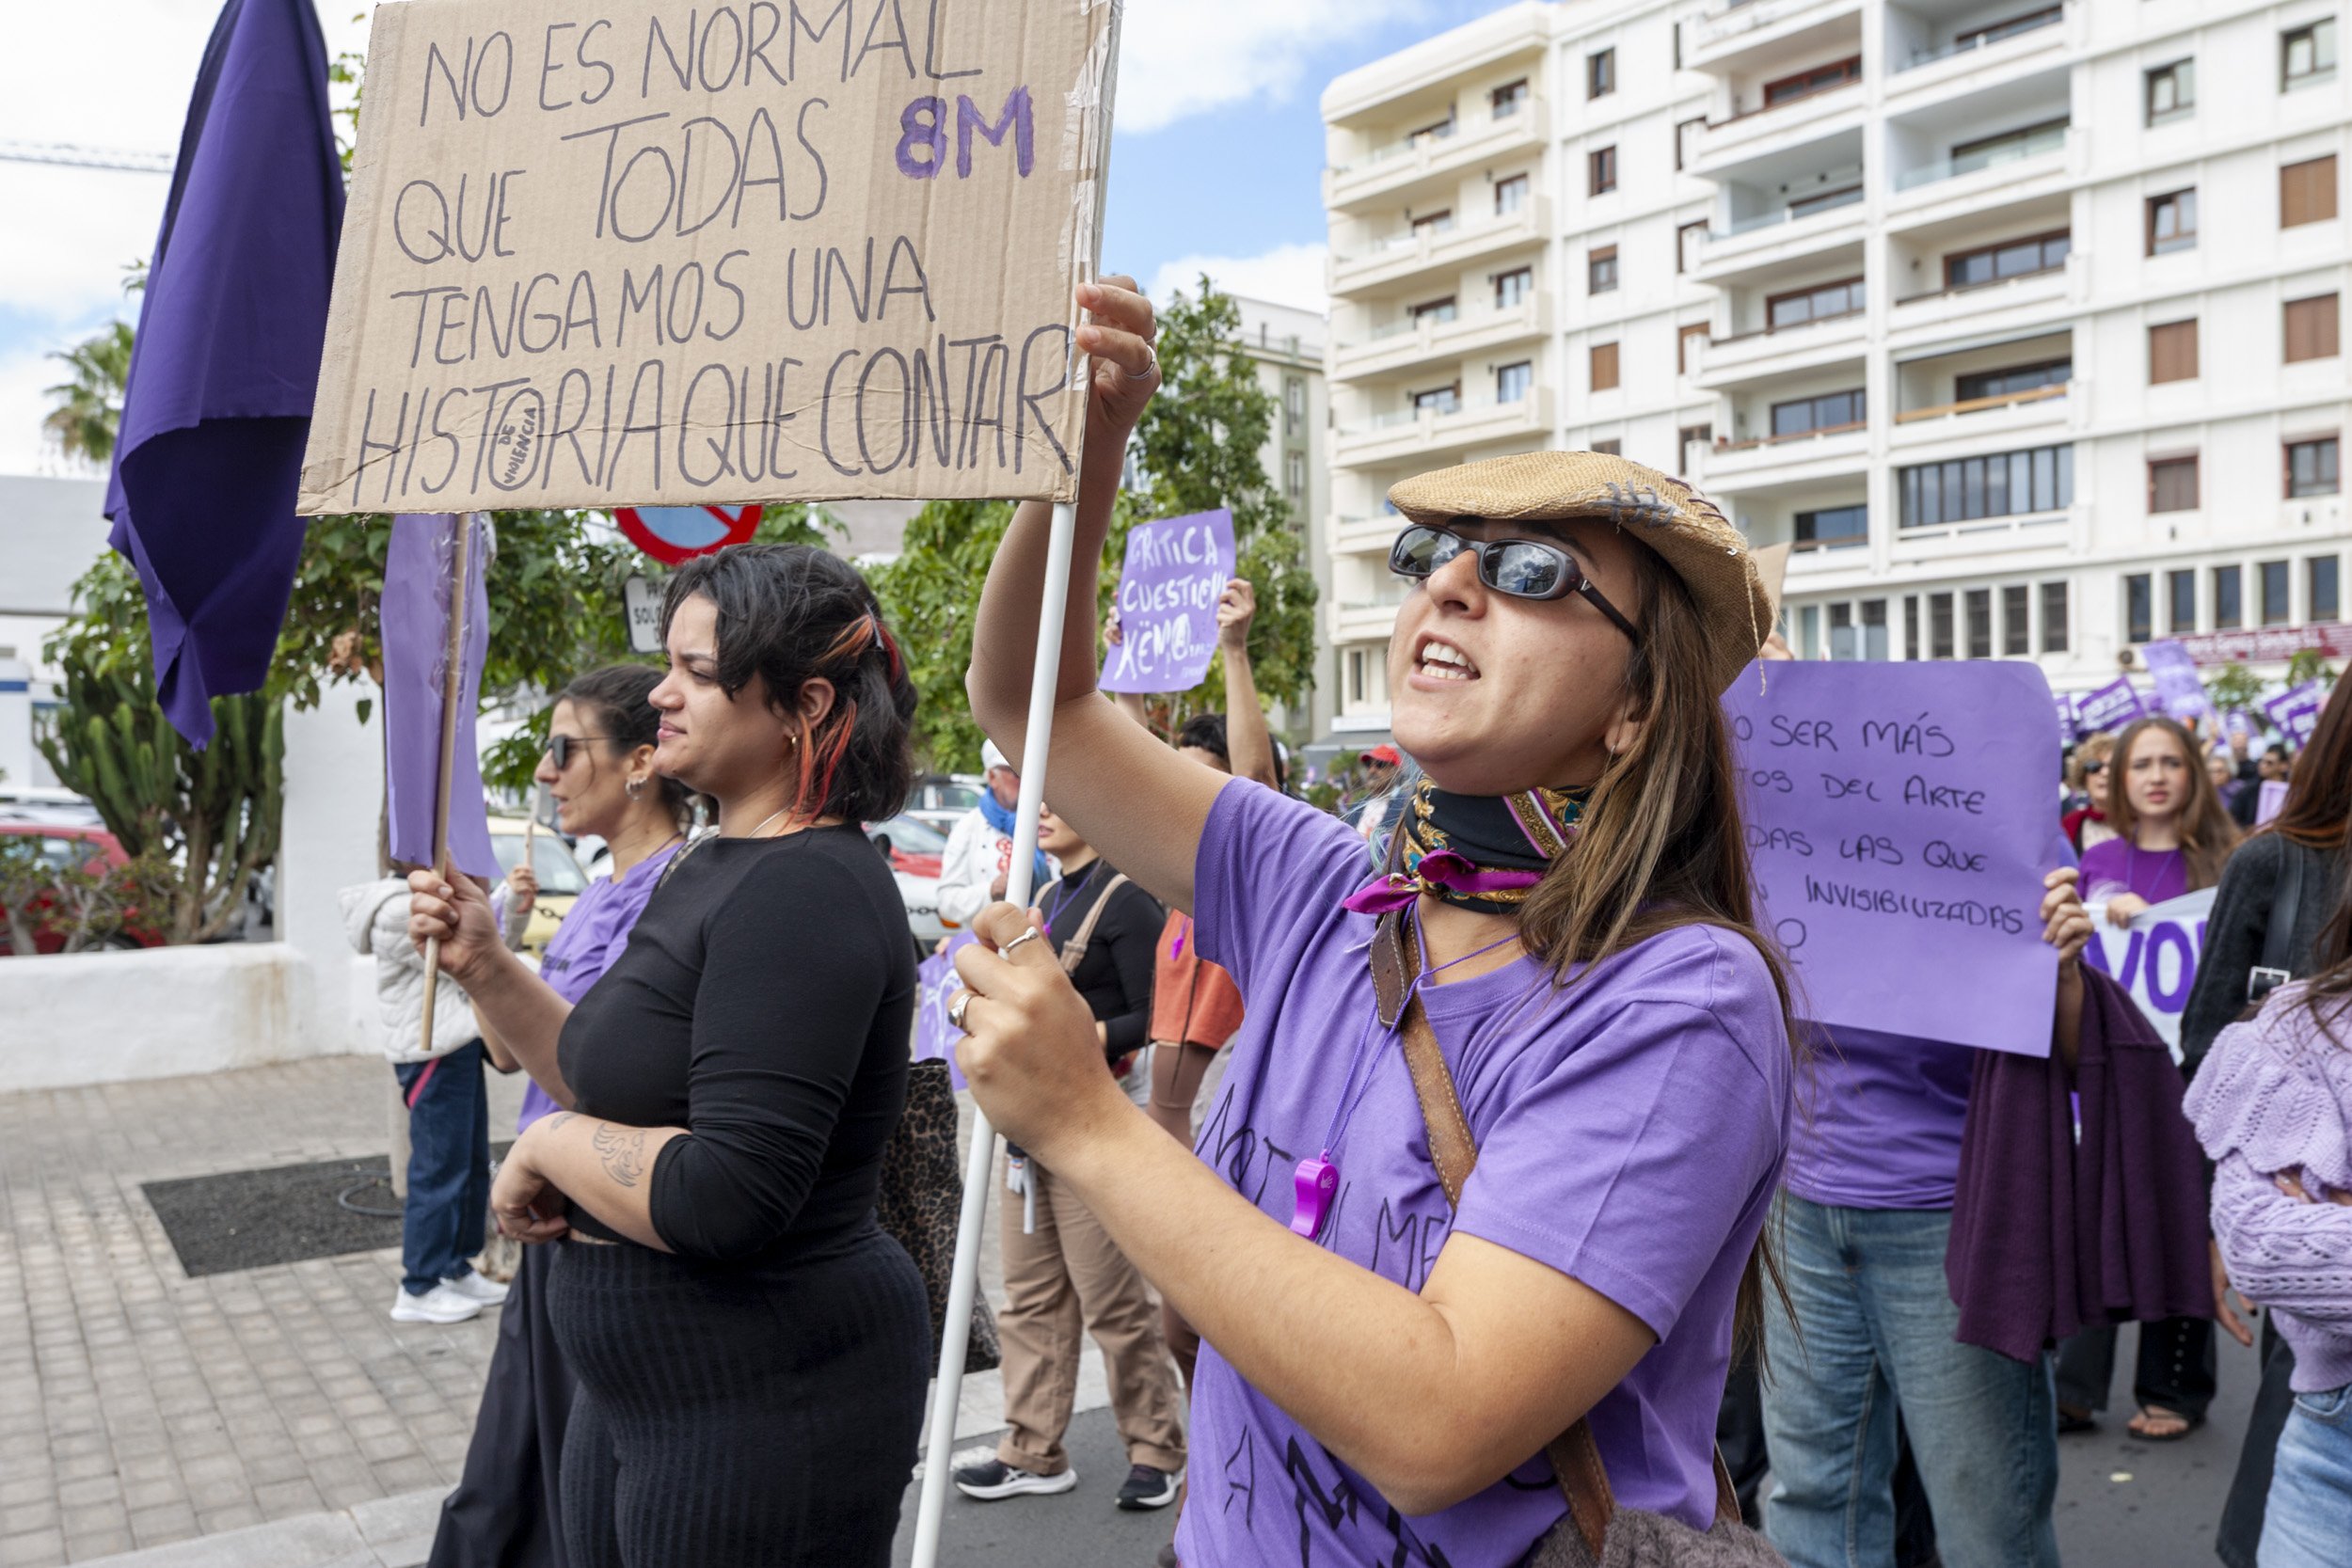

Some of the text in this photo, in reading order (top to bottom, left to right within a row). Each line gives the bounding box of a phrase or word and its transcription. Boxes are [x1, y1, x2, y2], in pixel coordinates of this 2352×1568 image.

[420, 0, 983, 127] NO ES NORMAL
[895, 85, 1035, 179] 8M
[394, 98, 828, 264] QUE TODAS
[390, 235, 935, 368] TENGAMOS UNA
[353, 324, 1074, 507] HISTORIA QUE CONTAR
[498, 424, 516, 445] DE
[503, 407, 536, 483] VIOLENCIA
[1770, 714, 1838, 752] SER
[1862, 712, 1956, 757] MÁS
[1820, 773, 1882, 802] DEL
[1904, 774, 1986, 816] ARTE
[1839, 833, 1903, 864] LAS
[1923, 840, 1989, 873] QUE
[2084, 920, 2210, 1014] VO
